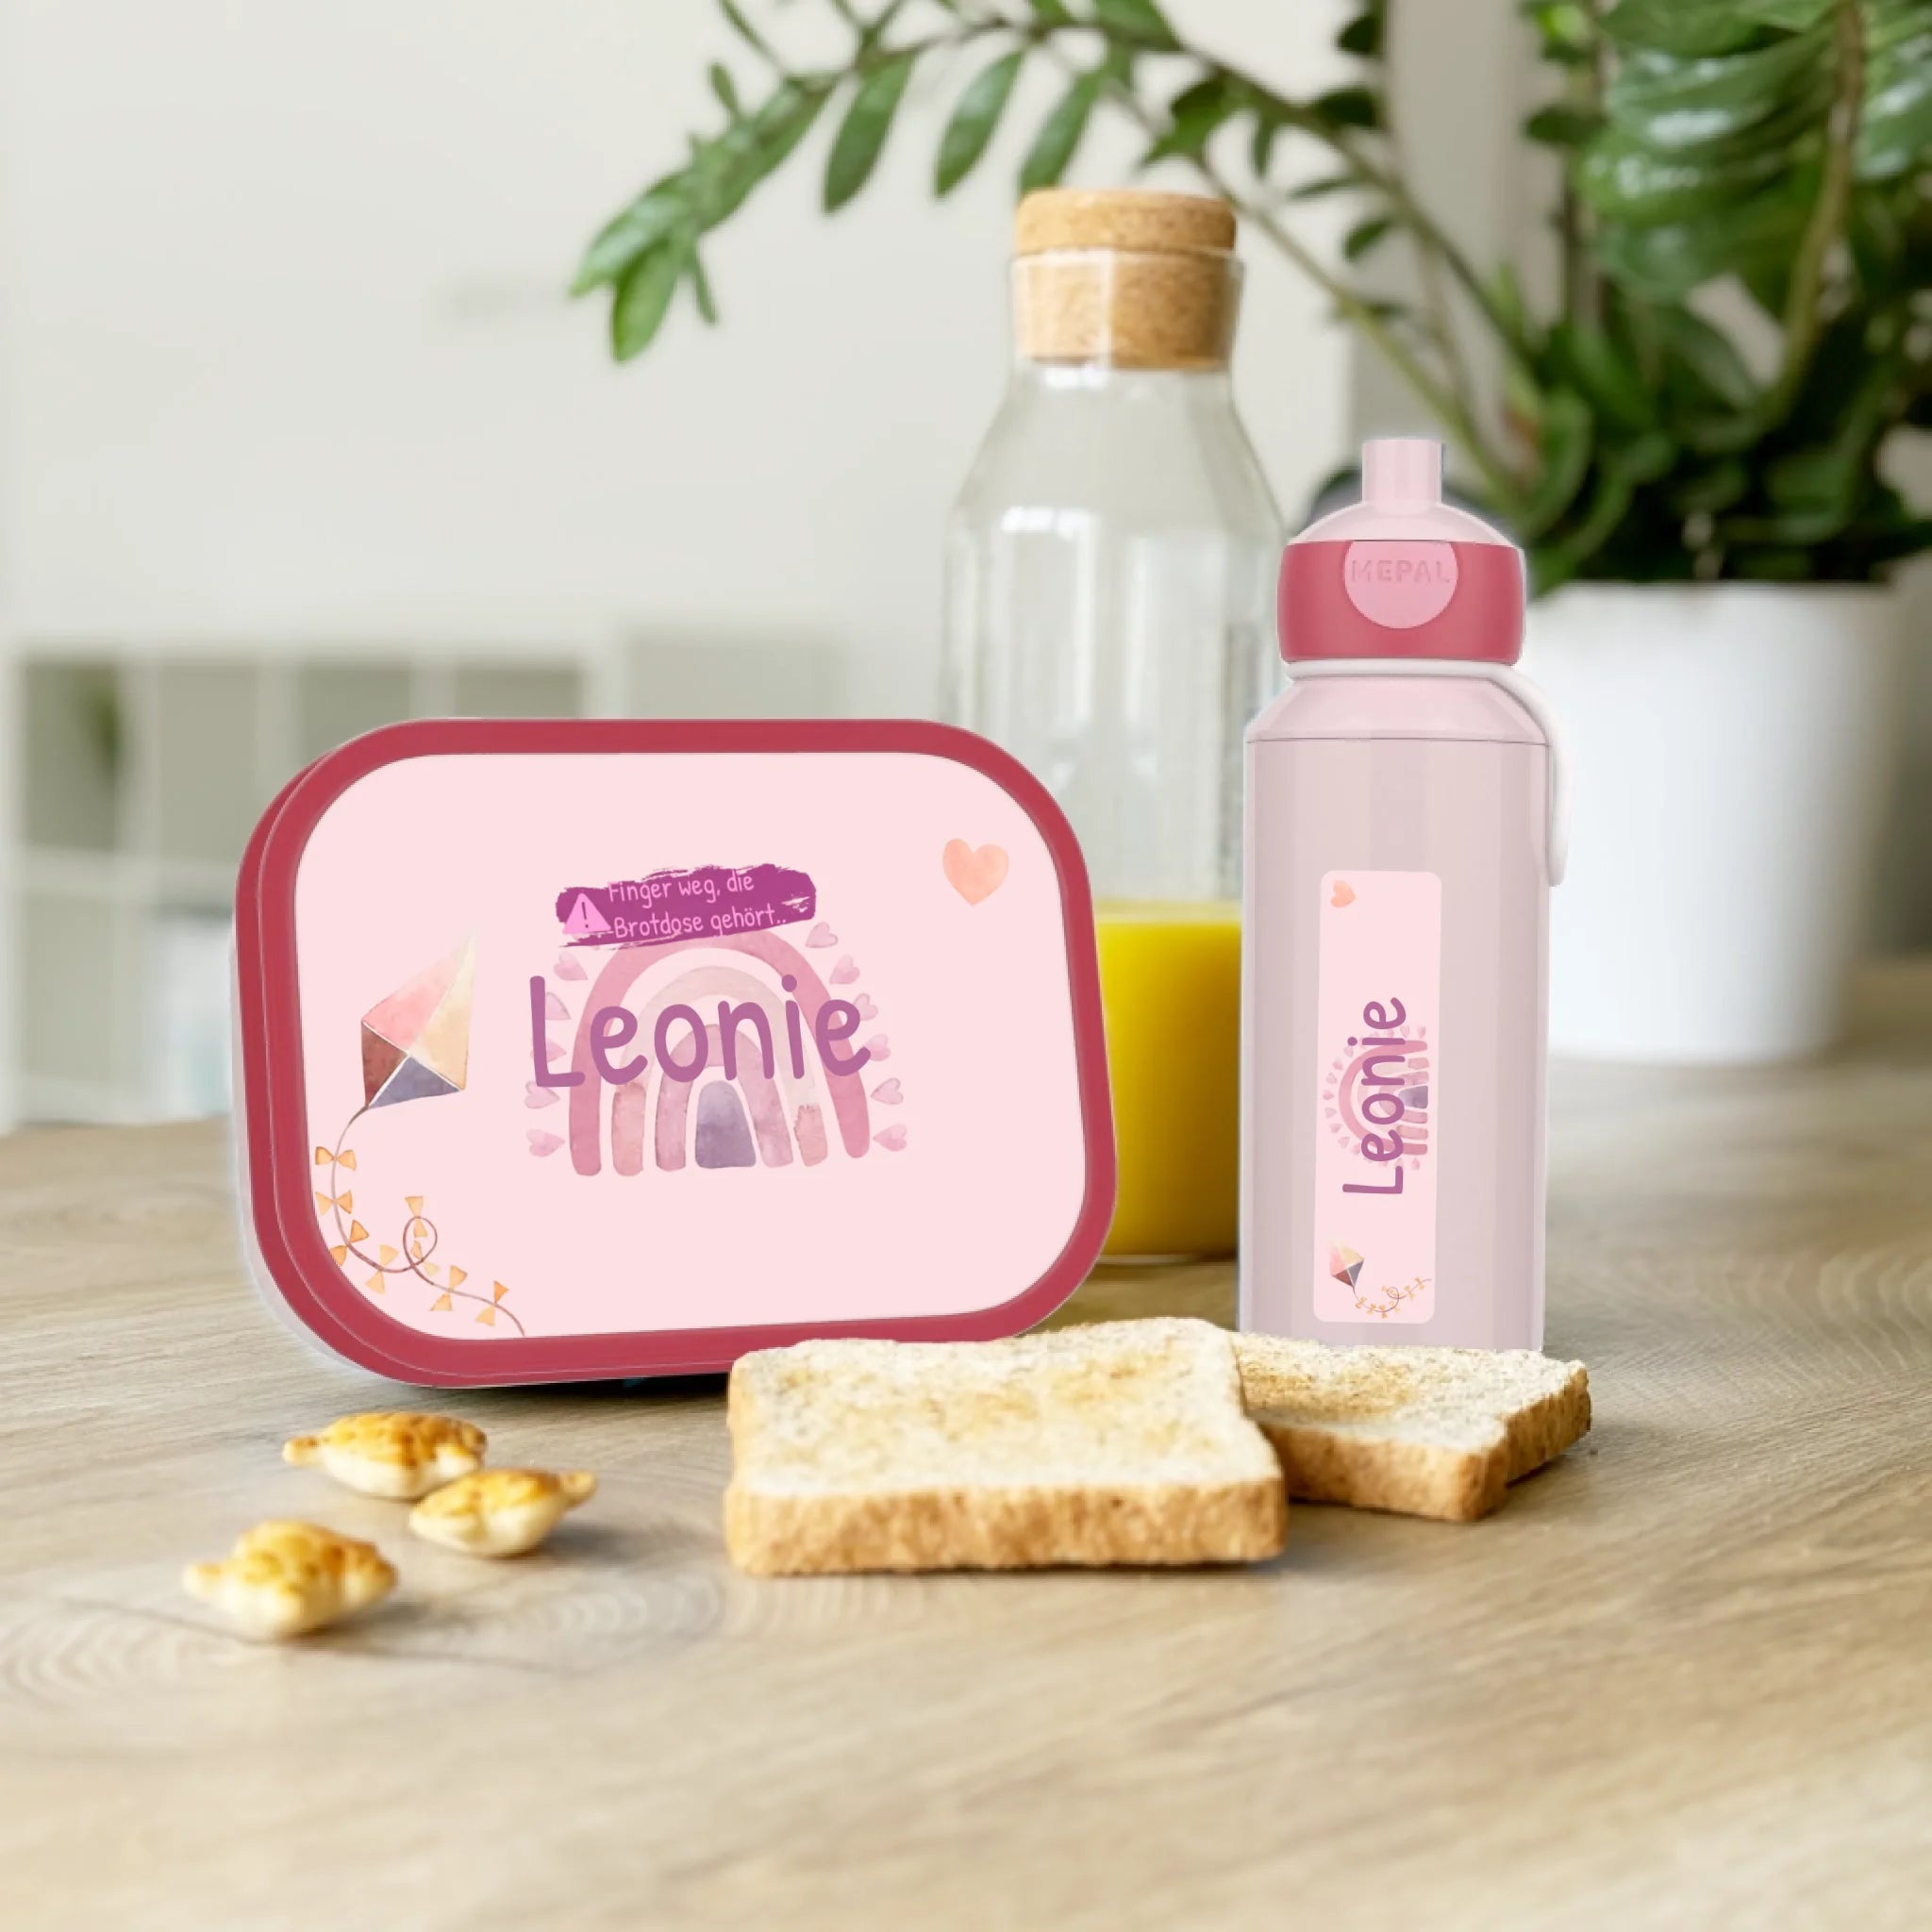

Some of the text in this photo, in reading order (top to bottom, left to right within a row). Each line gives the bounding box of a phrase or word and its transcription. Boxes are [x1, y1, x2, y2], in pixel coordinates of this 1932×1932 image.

[1351, 559, 1450, 583] MEPAL
[608, 870, 755, 908] Finger weg, die
[613, 911, 704, 939] Brotdose
[529, 974, 872, 1088] Leonie
[1341, 996, 1407, 1194] Leonie
